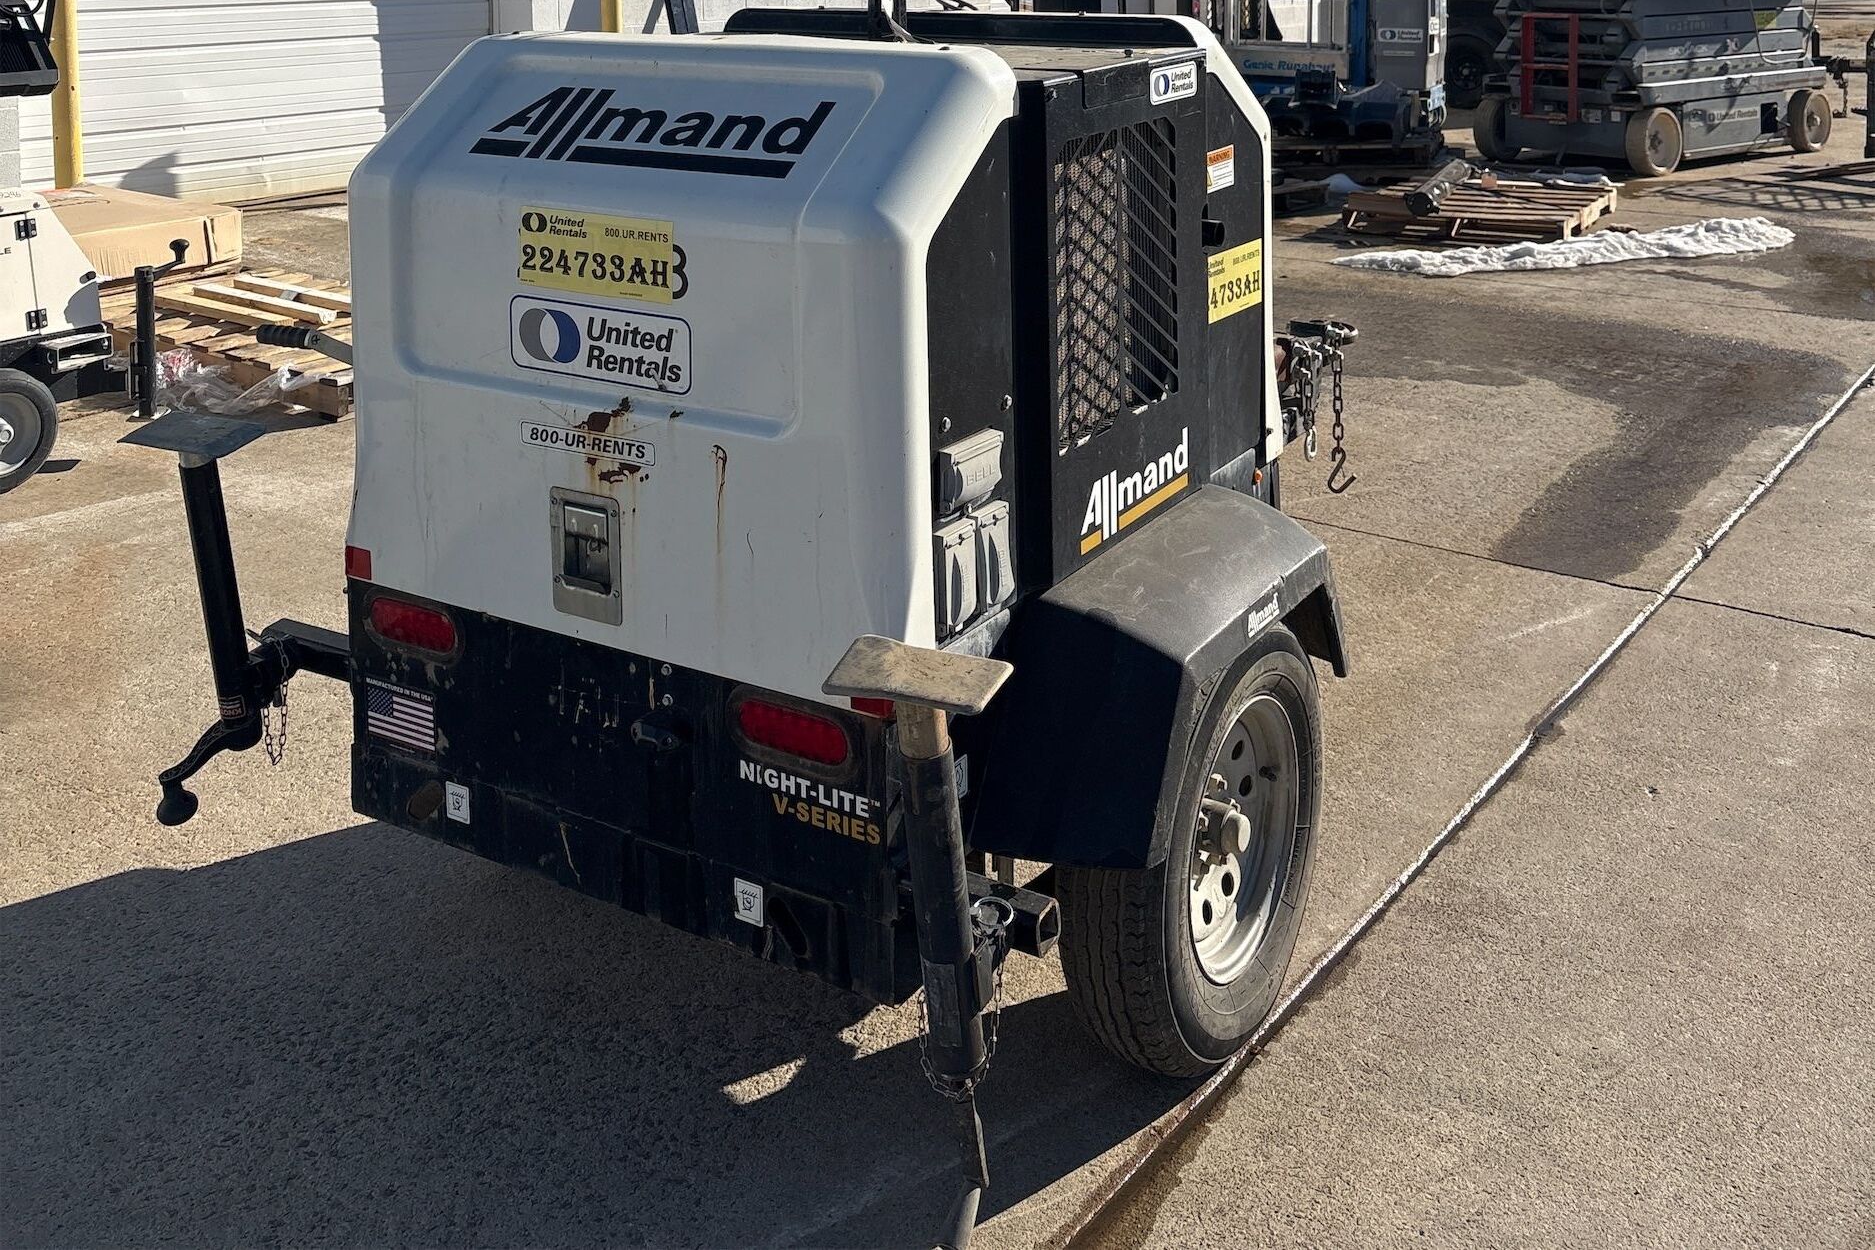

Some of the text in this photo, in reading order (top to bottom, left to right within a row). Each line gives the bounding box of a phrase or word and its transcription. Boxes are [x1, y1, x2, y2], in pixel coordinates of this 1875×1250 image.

[1171, 68, 1192, 82] United
[1243, 59, 1273, 70] Genie
[1171, 79, 1194, 93] Rentals
[487, 86, 837, 161] Allmand
[549, 215, 585, 228] United
[549, 225, 588, 239] Rentals
[604, 227, 669, 243] 800.UR.RENTS
[521, 243, 670, 289] 224733AH
[1210, 269, 1261, 310] 4733AH
[587, 316, 674, 352] United
[586, 344, 682, 383] Rentals
[530, 427, 647, 459] 800-UR-RENTS
[966, 463, 997, 487] BELL
[1080, 425, 1189, 542] Allmand
[1247, 593, 1280, 634] Allmand
[772, 793, 881, 845] V-SERIES
